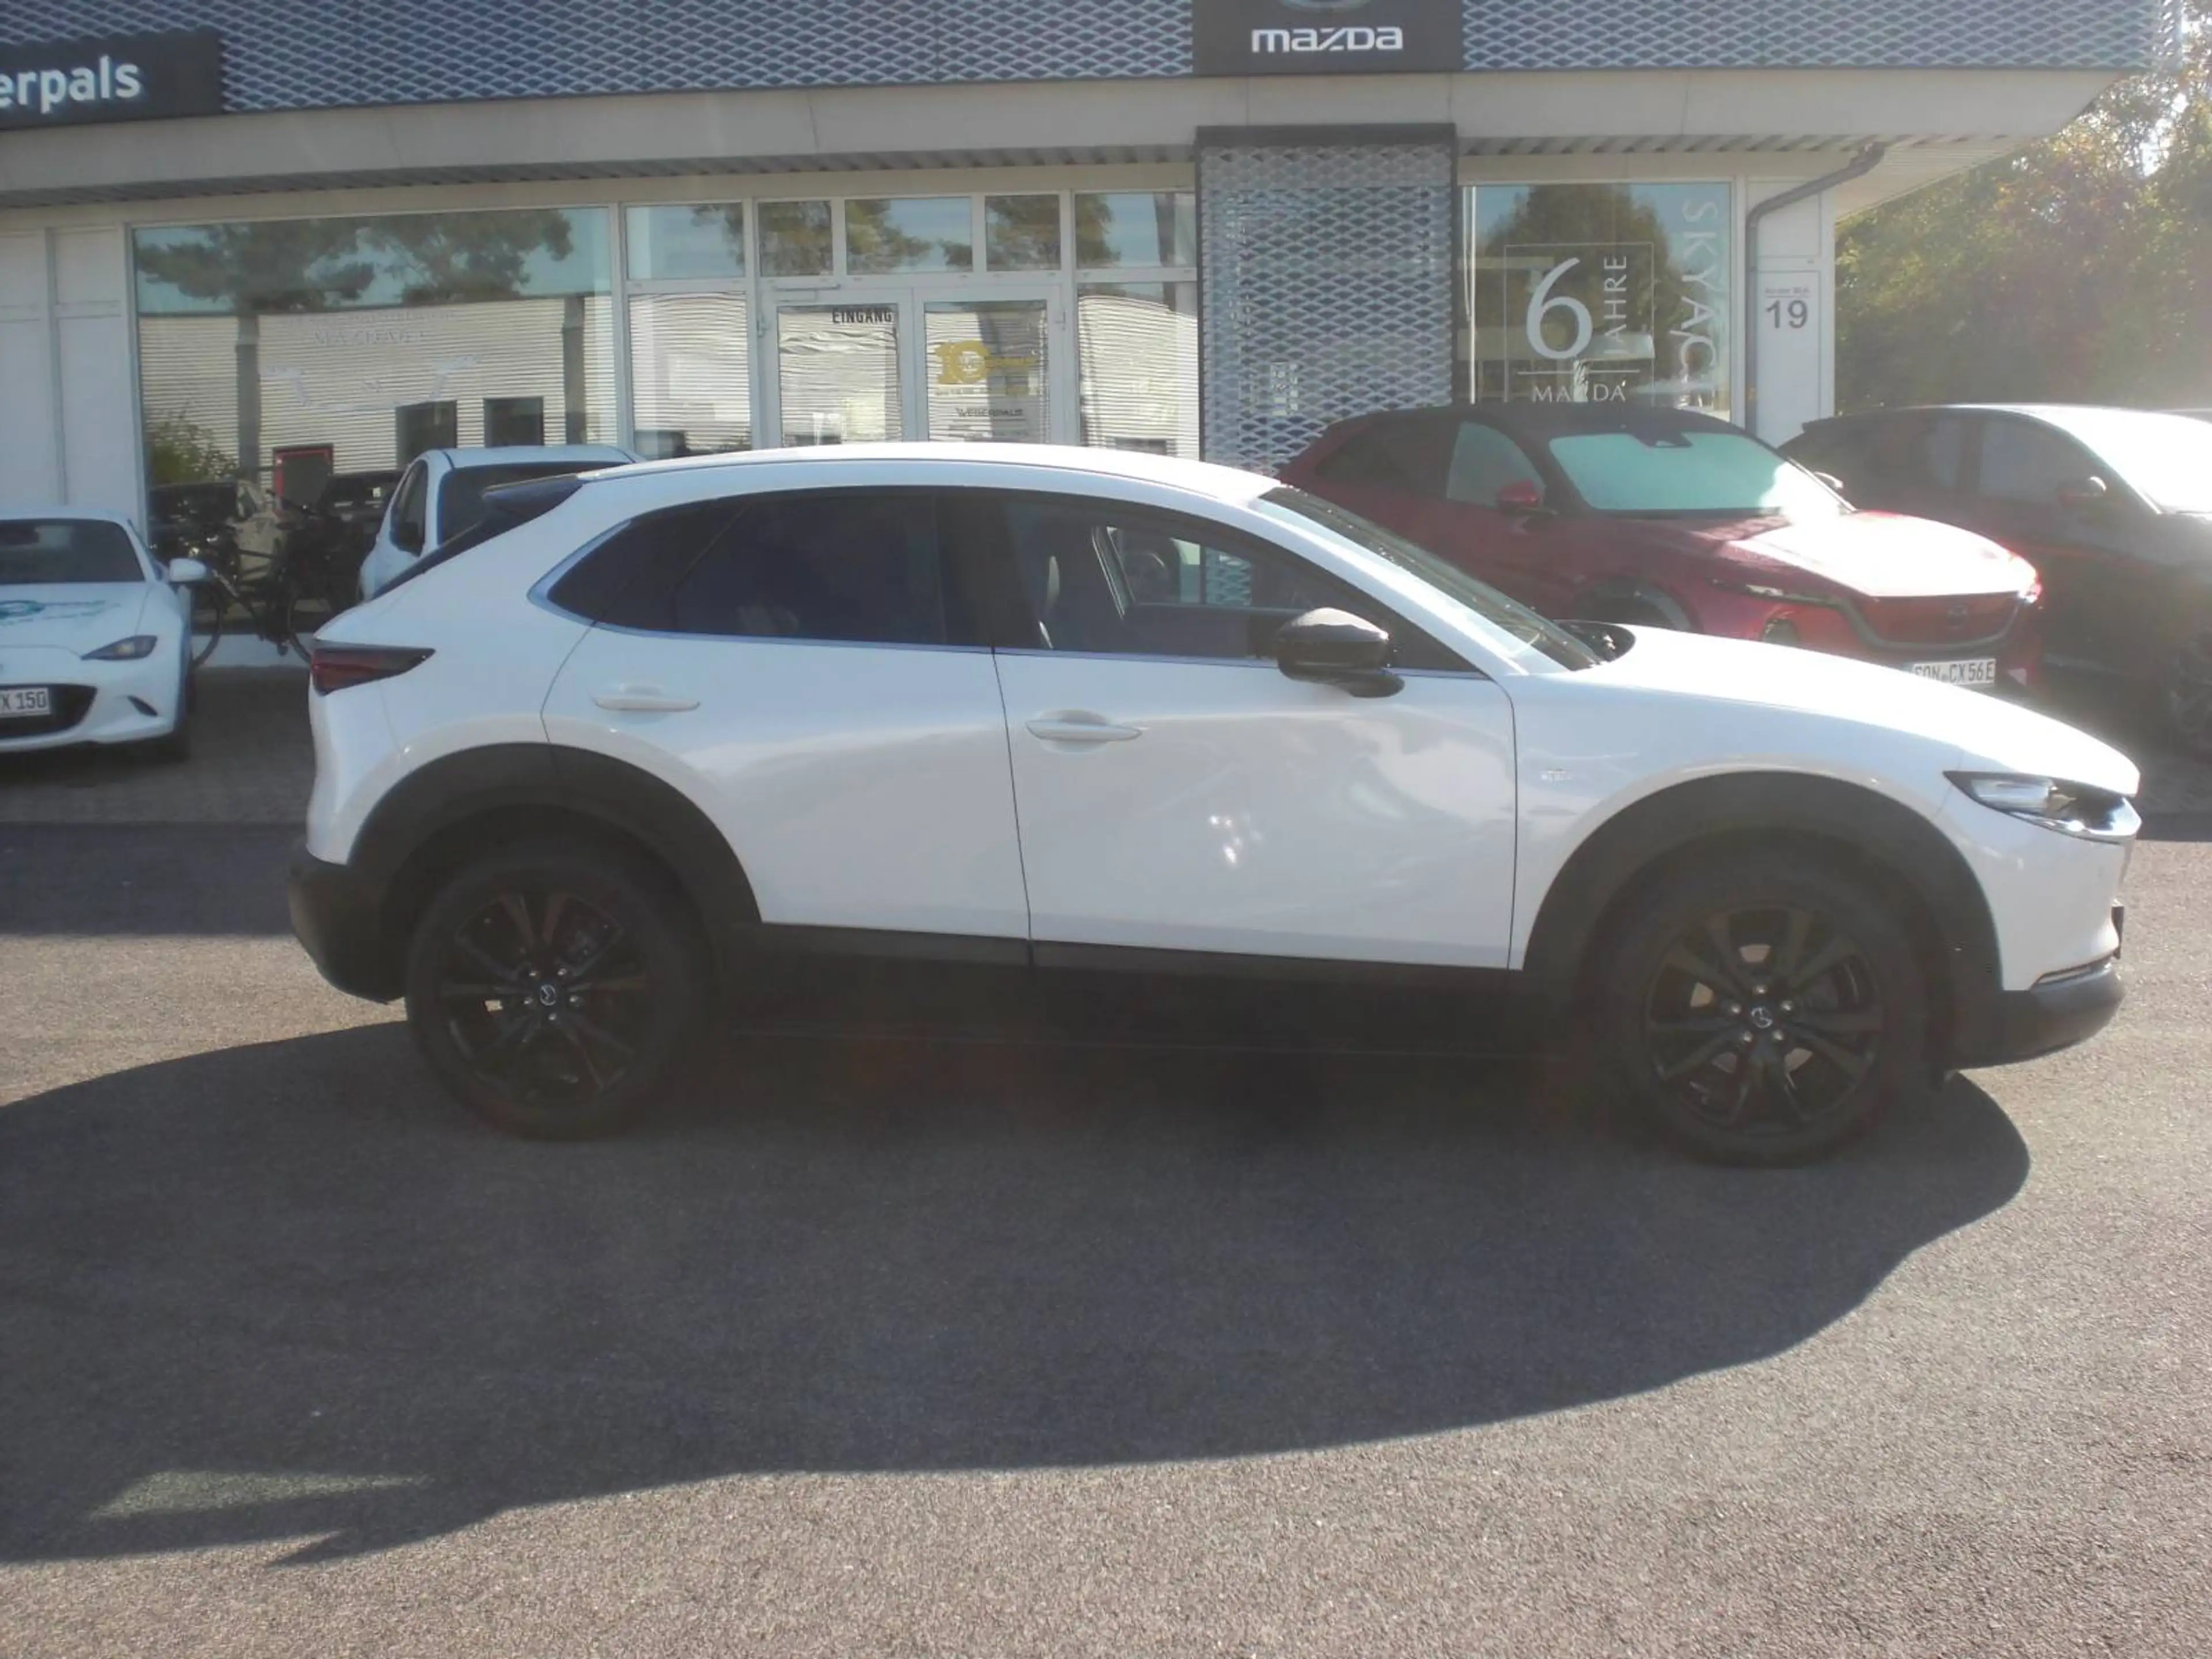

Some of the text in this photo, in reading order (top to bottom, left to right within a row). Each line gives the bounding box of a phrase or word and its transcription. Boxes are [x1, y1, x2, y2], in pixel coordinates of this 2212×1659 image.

[832, 308, 893, 323] EINGANG
[1527, 257, 1593, 359] 6
[1765, 299, 1808, 329] 19
[1532, 383, 1626, 403] MADA
[16, 691, 47, 710] 150
